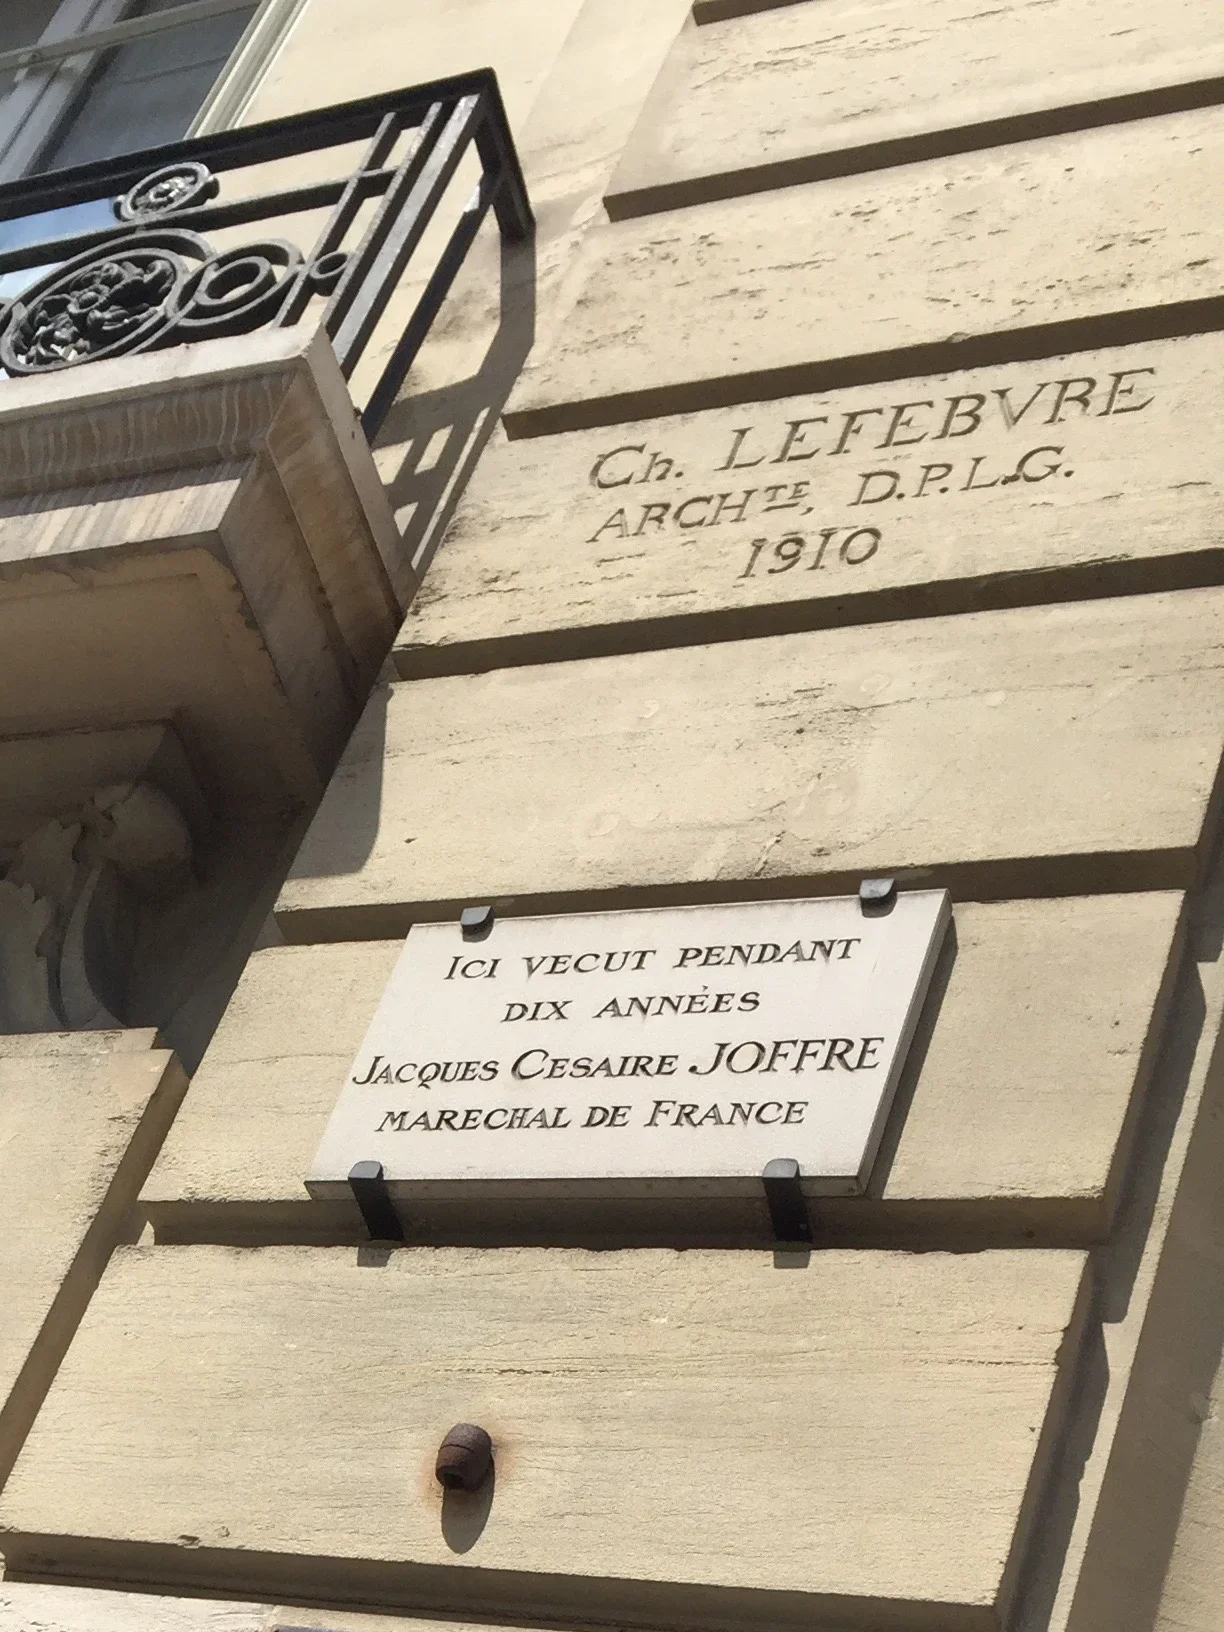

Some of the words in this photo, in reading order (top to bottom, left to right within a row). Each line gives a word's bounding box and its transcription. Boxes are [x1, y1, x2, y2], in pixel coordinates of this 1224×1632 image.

[588, 445, 684, 490] Ch.
[714, 367, 1155, 471] LEFEBVRE
[848, 446, 1074, 507] D.P.L.G.
[738, 527, 882, 579] 1910
[444, 955, 502, 981] ICI
[522, 950, 656, 979] VECUT
[672, 937, 860, 971] PENDANT
[501, 1000, 573, 1024] DIX
[592, 986, 761, 1019] ANNÉES
[352, 1055, 499, 1089] JACQUES
[510, 1049, 679, 1081] CESAIRE
[688, 1037, 885, 1075] JOFFRE
[375, 1105, 572, 1133] MARECHAL
[581, 1104, 632, 1130] DE
[644, 1100, 809, 1130] FRANCE
